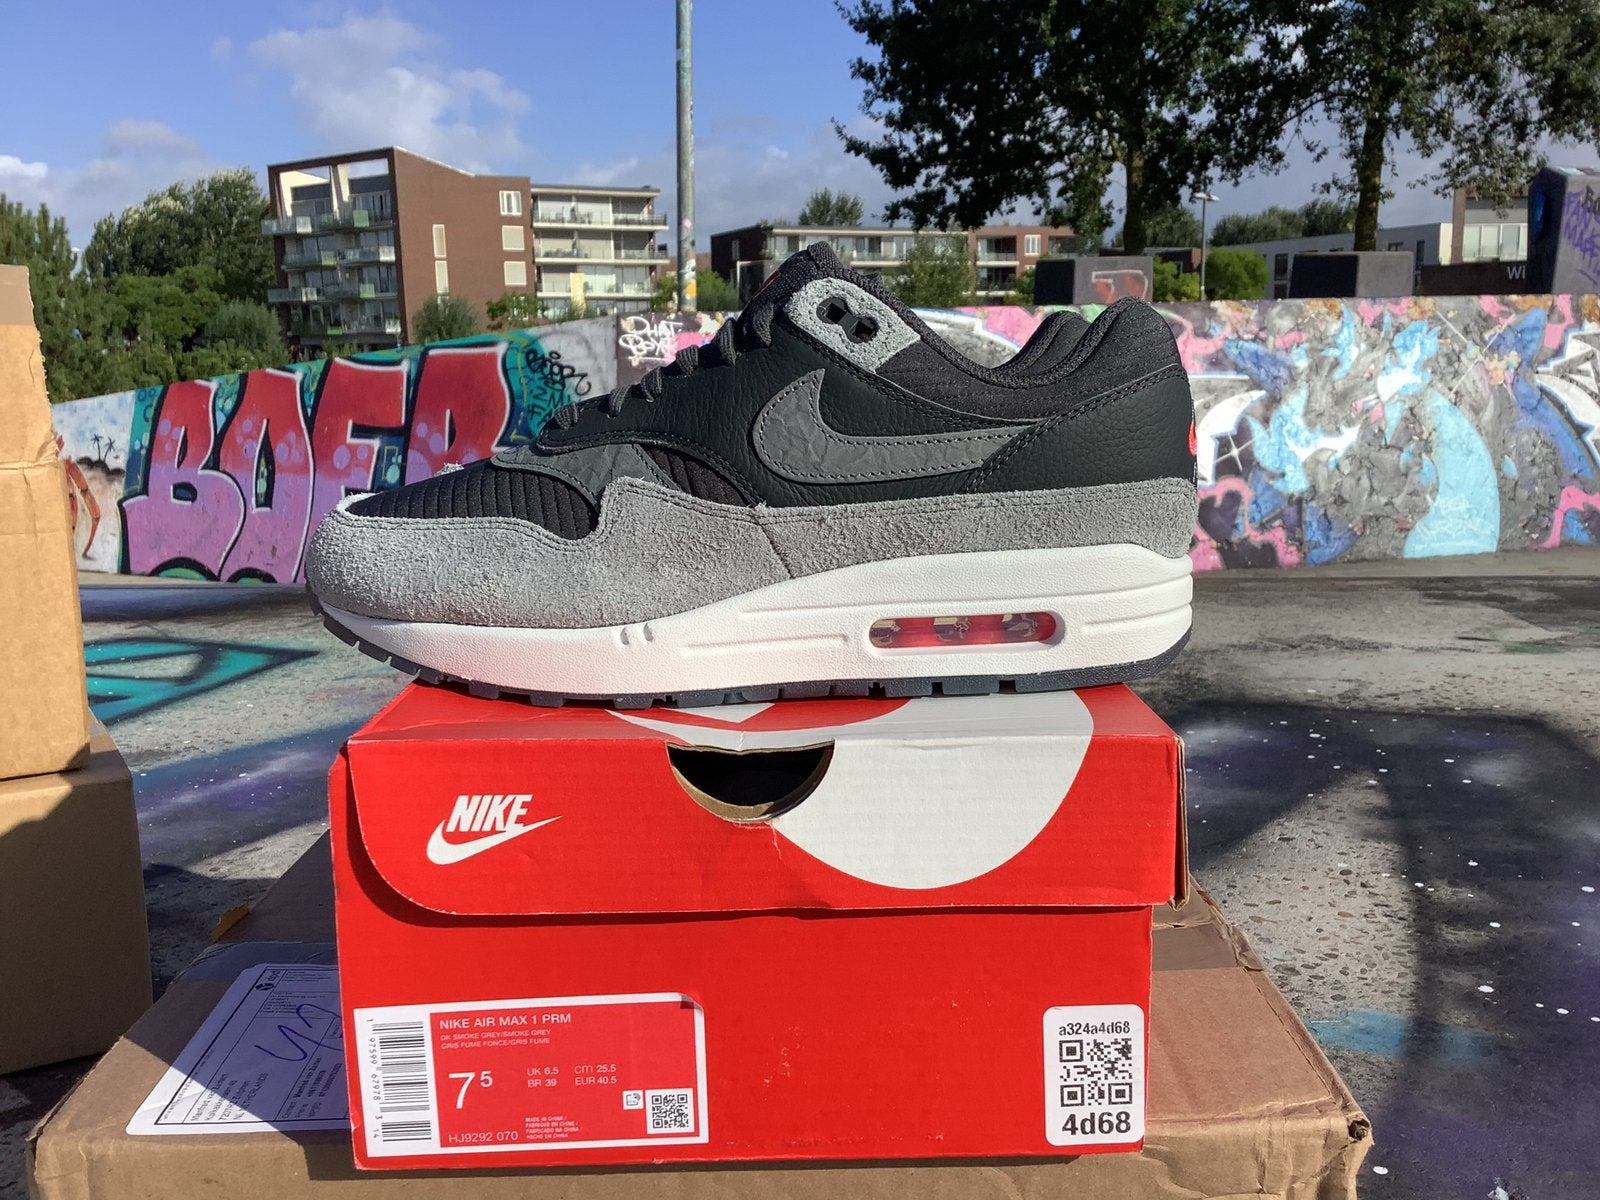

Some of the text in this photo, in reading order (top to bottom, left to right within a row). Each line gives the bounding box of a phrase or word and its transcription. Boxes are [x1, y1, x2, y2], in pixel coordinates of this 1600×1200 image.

[446, 794, 533, 832] NIKE
[440, 1013, 571, 1030] NIKE AIR MAX 1 PRM
[1058, 1021, 1131, 1036] a324a4d68
[452, 1032, 479, 1040] SMOKE
[481, 1030, 529, 1039] GREY/SMOKE
[369, 1037, 378, 1065] 97599
[527, 1066, 560, 1076] UK 6.5
[596, 1064, 617, 1073] 25.5
[371, 1073, 381, 1100] 67978
[527, 1078, 557, 1088] BR 39
[575, 1075, 617, 1086] EUR 40.5
[1061, 1111, 1131, 1136] 4d68
[448, 1130, 518, 1143] HJ9292 070
